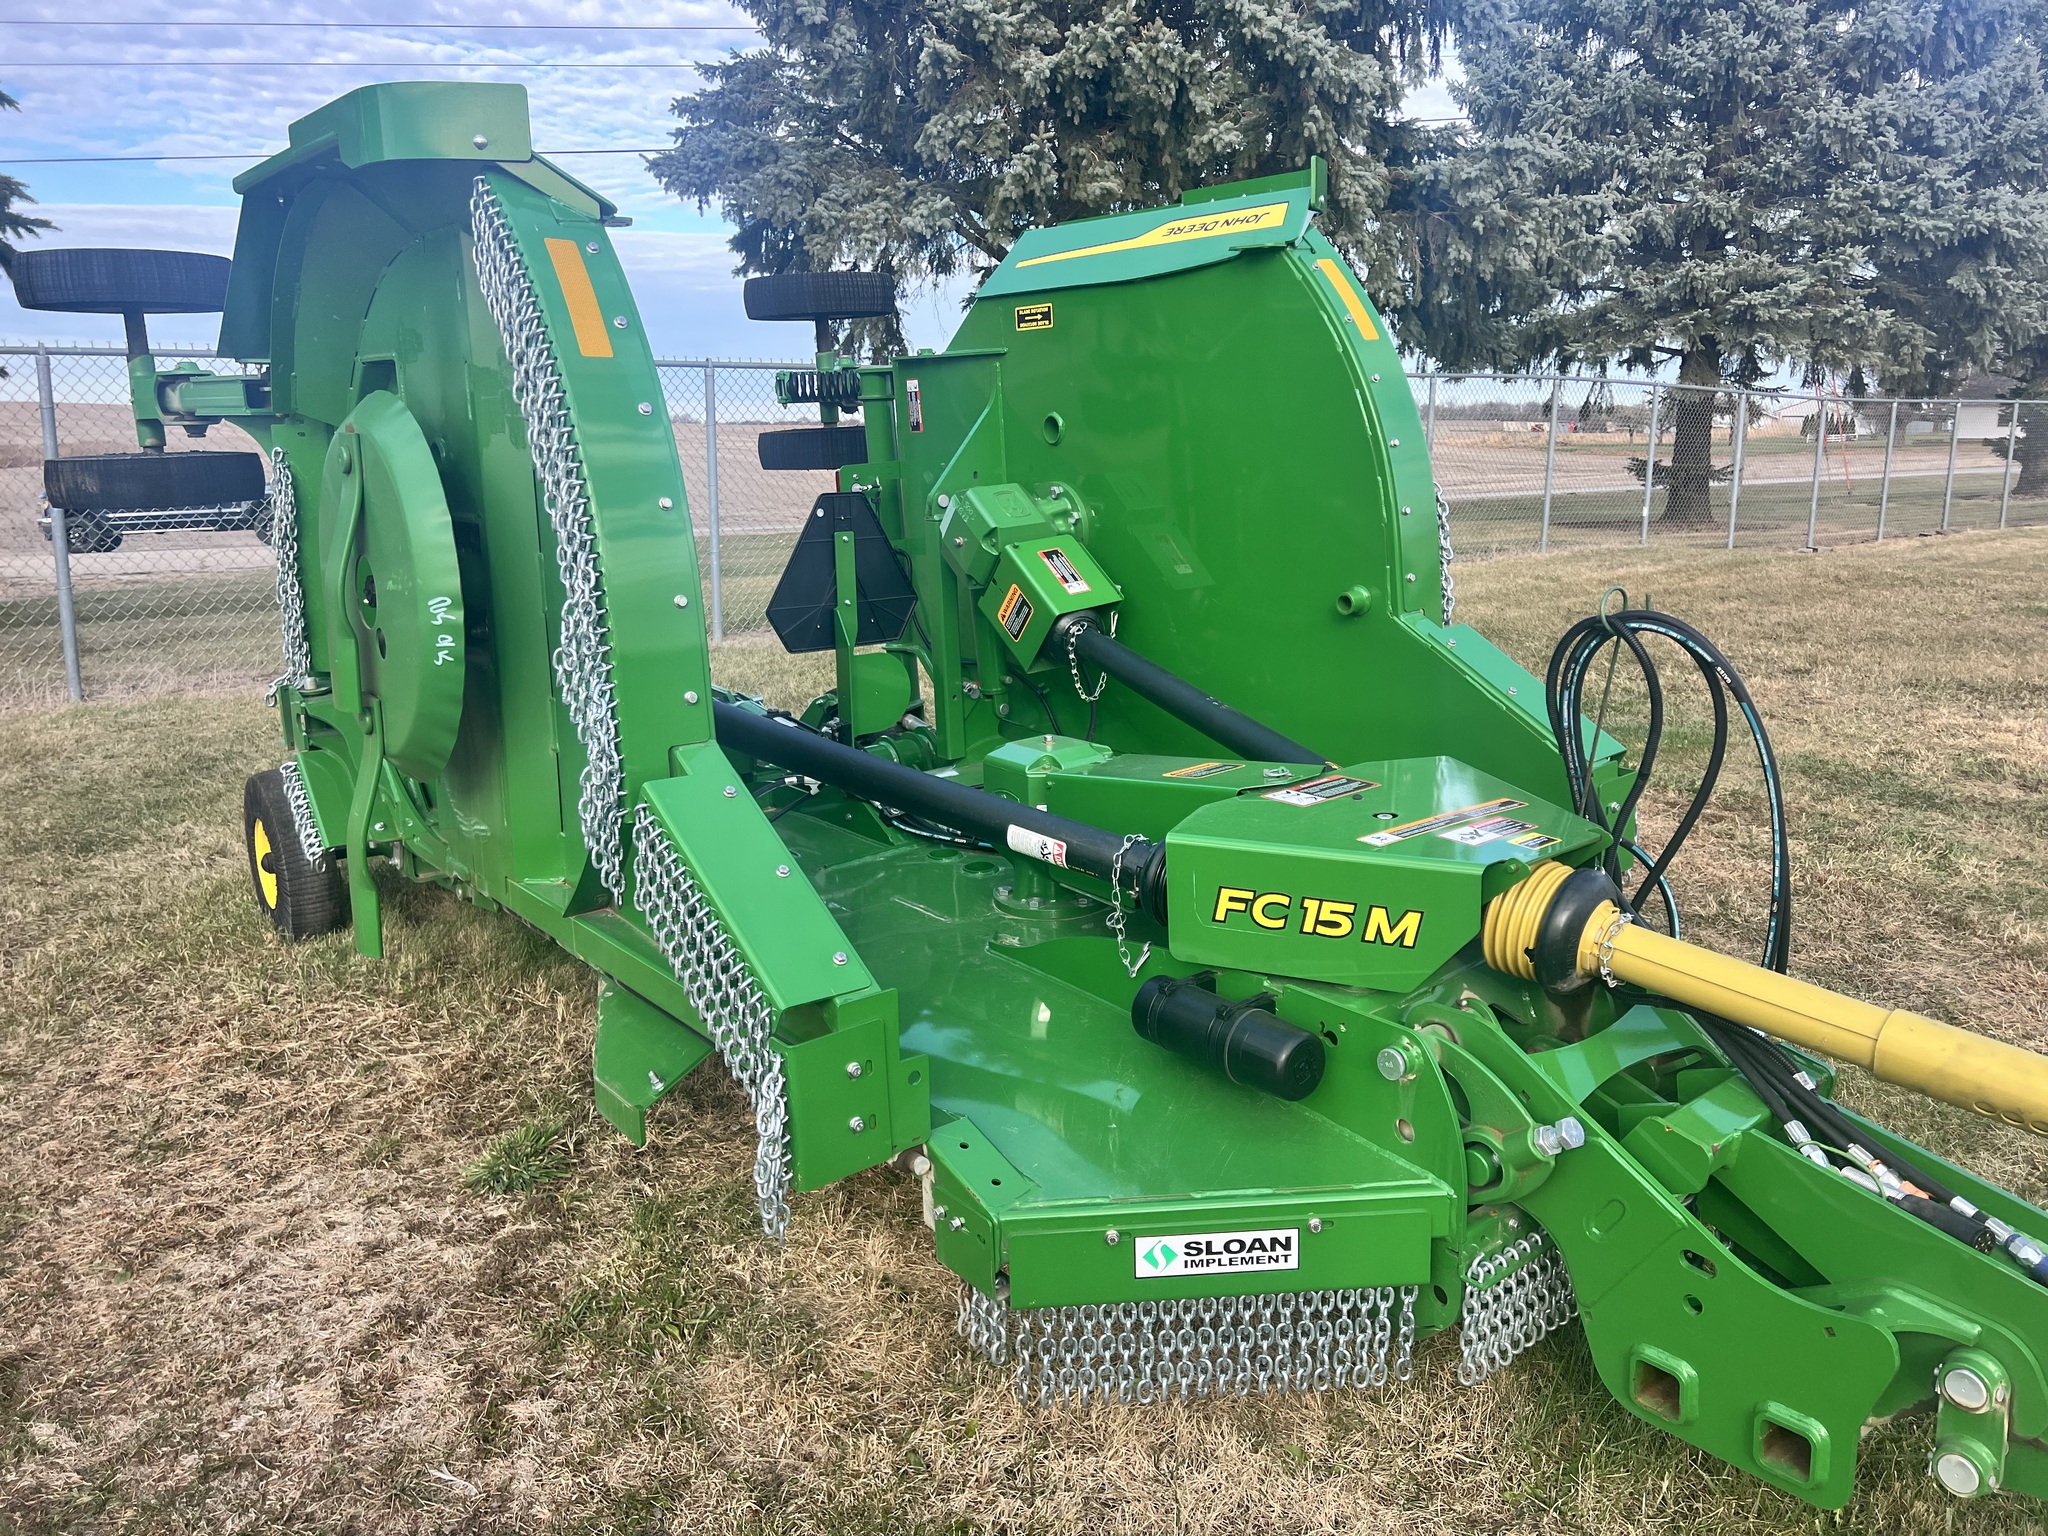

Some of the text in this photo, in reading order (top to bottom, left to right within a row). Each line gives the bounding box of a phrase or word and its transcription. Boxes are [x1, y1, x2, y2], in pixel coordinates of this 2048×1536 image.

[1162, 211, 1271, 238] JOHN DEERE
[1003, 587, 1019, 614] WARNING
[1212, 885, 1424, 949] FC 15 M
[1184, 1236, 1292, 1257] SLOAN
[1184, 1254, 1292, 1268] IMPLEMENT
